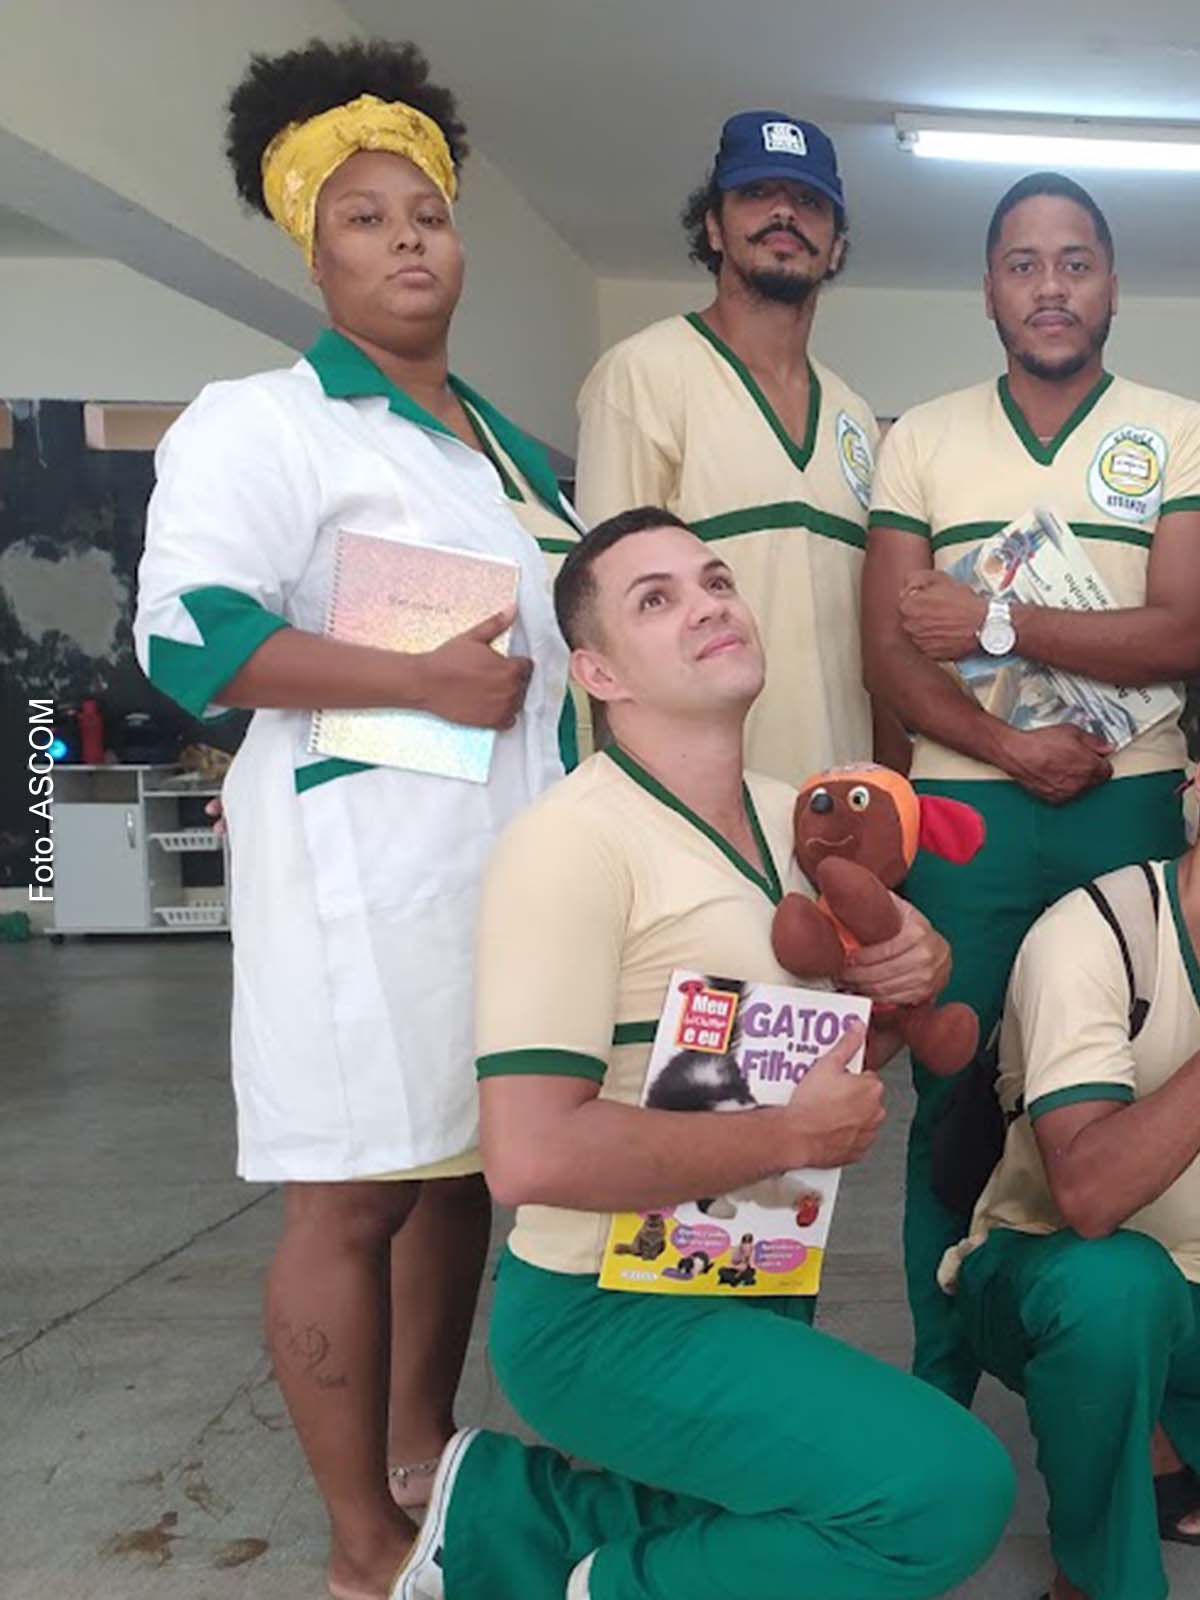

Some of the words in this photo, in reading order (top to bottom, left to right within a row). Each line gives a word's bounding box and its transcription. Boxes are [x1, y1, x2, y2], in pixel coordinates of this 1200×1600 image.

[692, 993, 730, 1017] Meu
[697, 1029, 721, 1047] eu
[740, 1049, 814, 1084] Filho
